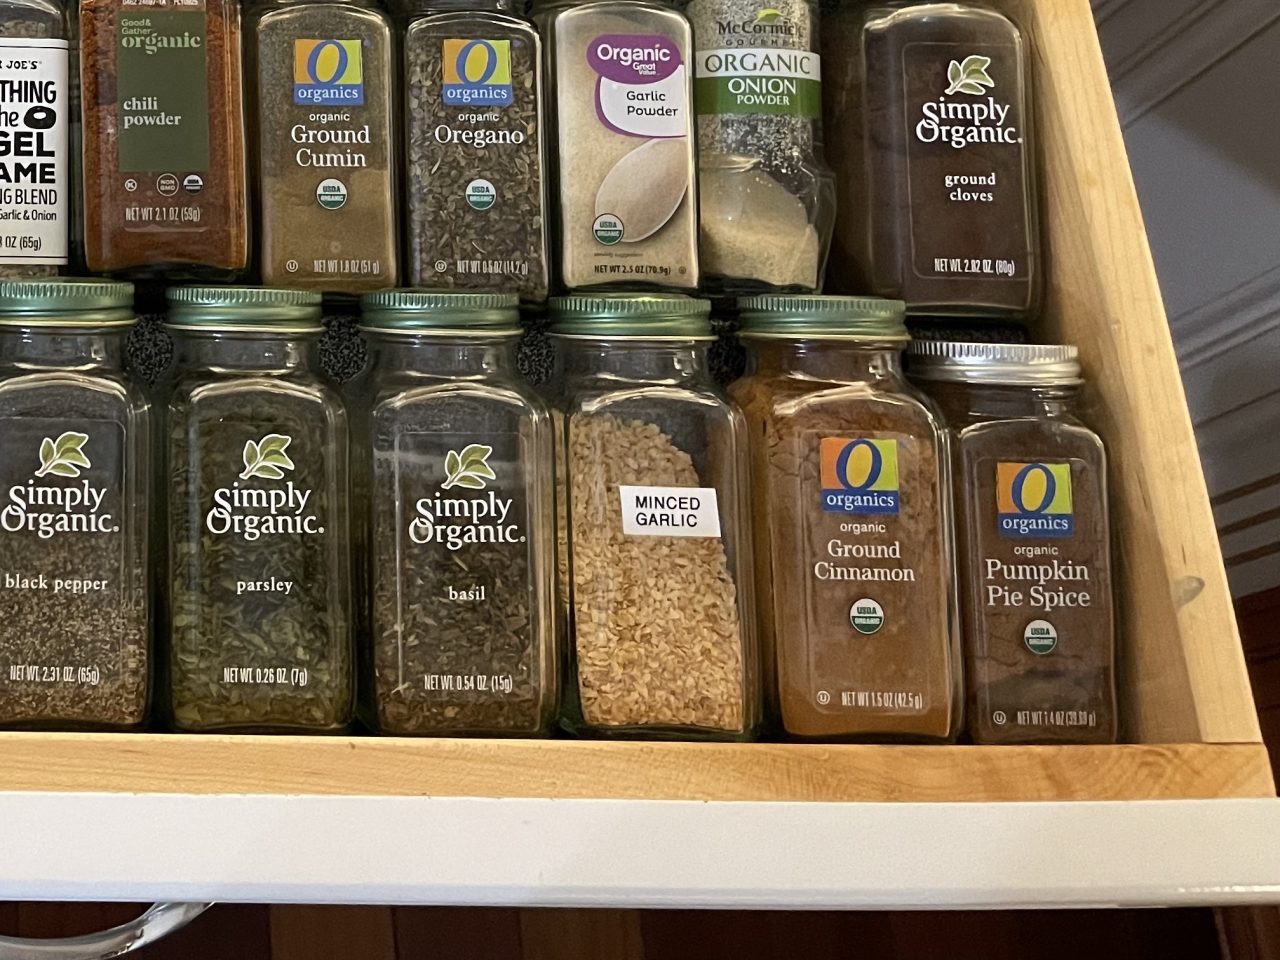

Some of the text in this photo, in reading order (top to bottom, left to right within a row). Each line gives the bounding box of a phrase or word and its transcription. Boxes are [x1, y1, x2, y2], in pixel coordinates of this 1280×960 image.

[121, 32, 201, 55] organic
[307, 39, 348, 85] O
[597, 43, 671, 65] Organic
[6, 60, 38, 70] JOE'S
[705, 53, 810, 75] ORGANIC
[728, 78, 796, 94] ONION
[298, 87, 359, 103] organics
[447, 87, 508, 103] organics
[626, 90, 666, 102] Garlic
[737, 95, 790, 106] POWDER
[123, 97, 158, 111] chili
[627, 105, 678, 117] Powder
[922, 96, 1010, 126] Simply
[123, 112, 182, 130] powder
[309, 112, 351, 123] organic
[458, 112, 500, 123] organic
[291, 125, 371, 144] Ground
[434, 124, 524, 148] Oregano
[296, 148, 367, 167] Cumin
[945, 173, 996, 187] ground
[14, 188, 57, 205] BLEND
[950, 188, 993, 201] cloves
[31, 209, 57, 221] Onion
[9, 479, 107, 512] Simply
[213, 481, 311, 514] Simply
[635, 495, 701, 510] MINCED
[826, 493, 895, 510] organics
[416, 491, 513, 524] Simply
[636, 512, 698, 528] GARLIC
[840, 522, 886, 535] organic
[1002, 516, 1069, 534] organics
[827, 540, 901, 560] Ground
[1014, 544, 1059, 558] organic
[814, 561, 916, 582] Cinnamon
[985, 558, 1090, 585] Pumpkin
[5, 573, 108, 594] black pepper
[236, 577, 293, 594] parsley
[448, 585, 486, 601] basil
[986, 585, 1091, 612] Pie Spice
